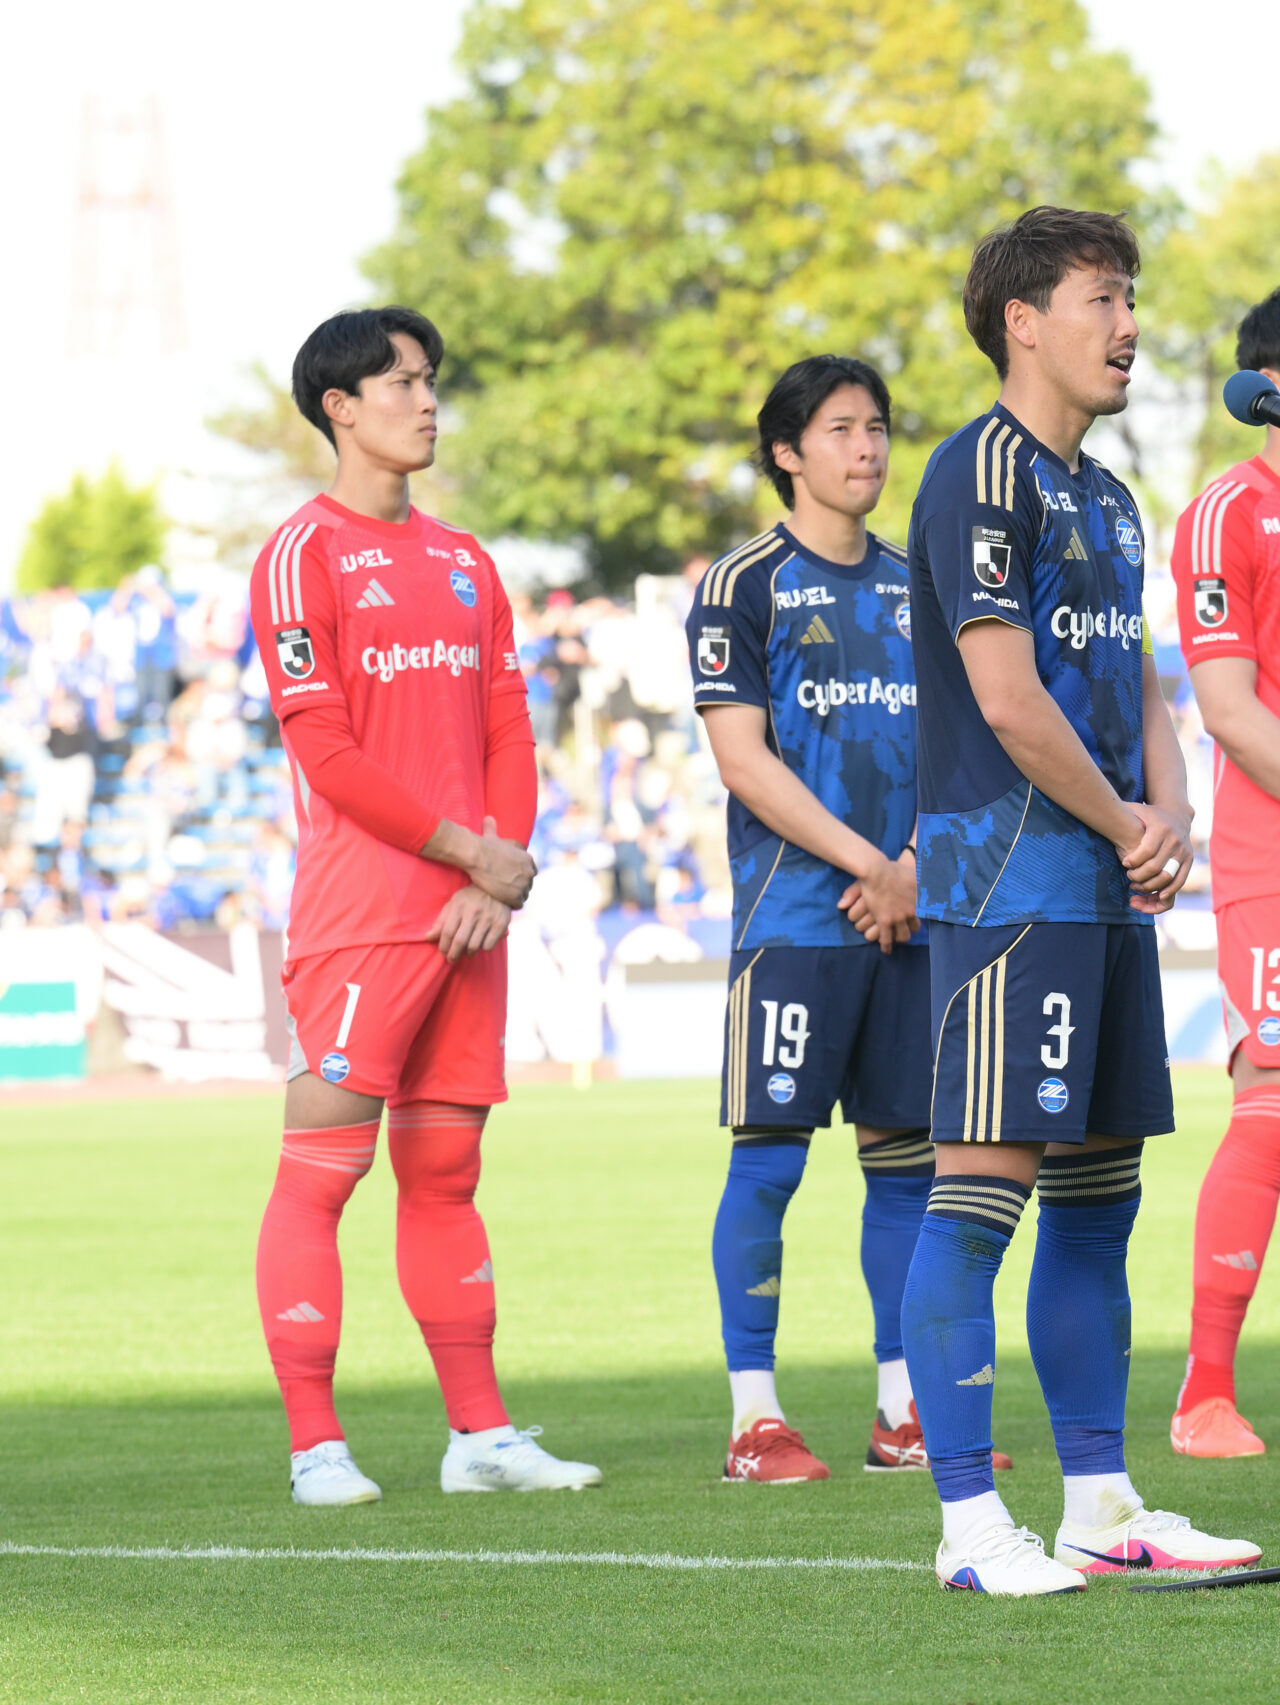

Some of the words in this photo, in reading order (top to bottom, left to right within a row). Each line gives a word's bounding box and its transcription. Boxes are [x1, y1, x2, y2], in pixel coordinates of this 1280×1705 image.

[972, 591, 1020, 610] MAHIDA
[1051, 605, 1143, 651] CybeAgen
[335, 982, 361, 1049] 1
[760, 1000, 812, 1069] 19
[1041, 992, 1076, 1070] 3
